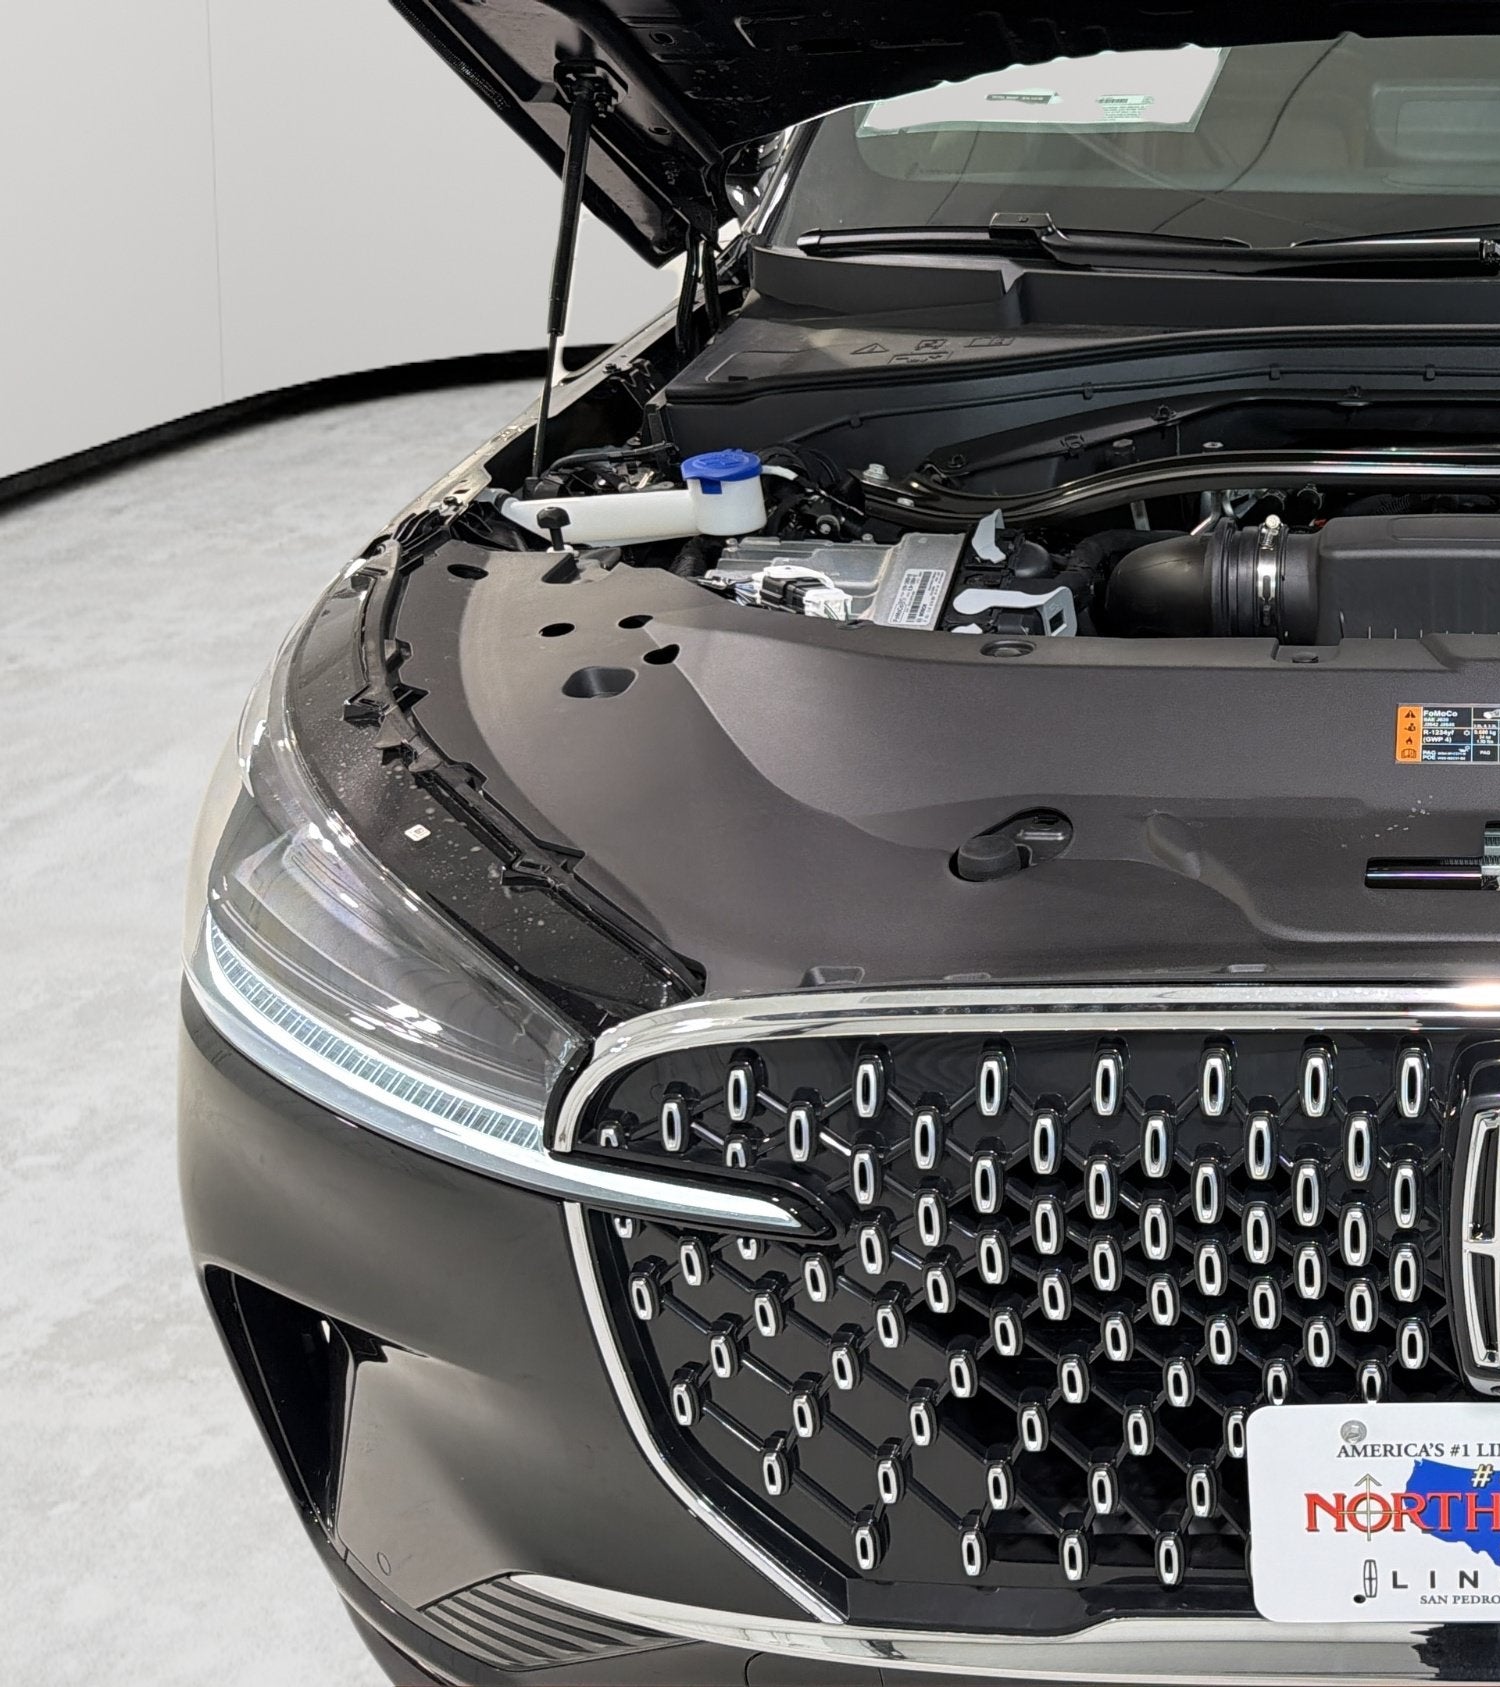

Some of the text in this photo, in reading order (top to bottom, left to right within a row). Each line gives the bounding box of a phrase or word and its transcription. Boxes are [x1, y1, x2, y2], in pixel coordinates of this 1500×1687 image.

[1336, 1443, 1444, 1458] AMERICA'S
[1450, 1444, 1470, 1457] #1
[1420, 1595, 1448, 1604] SAN
[1452, 1595, 1500, 1604] PEDRO
